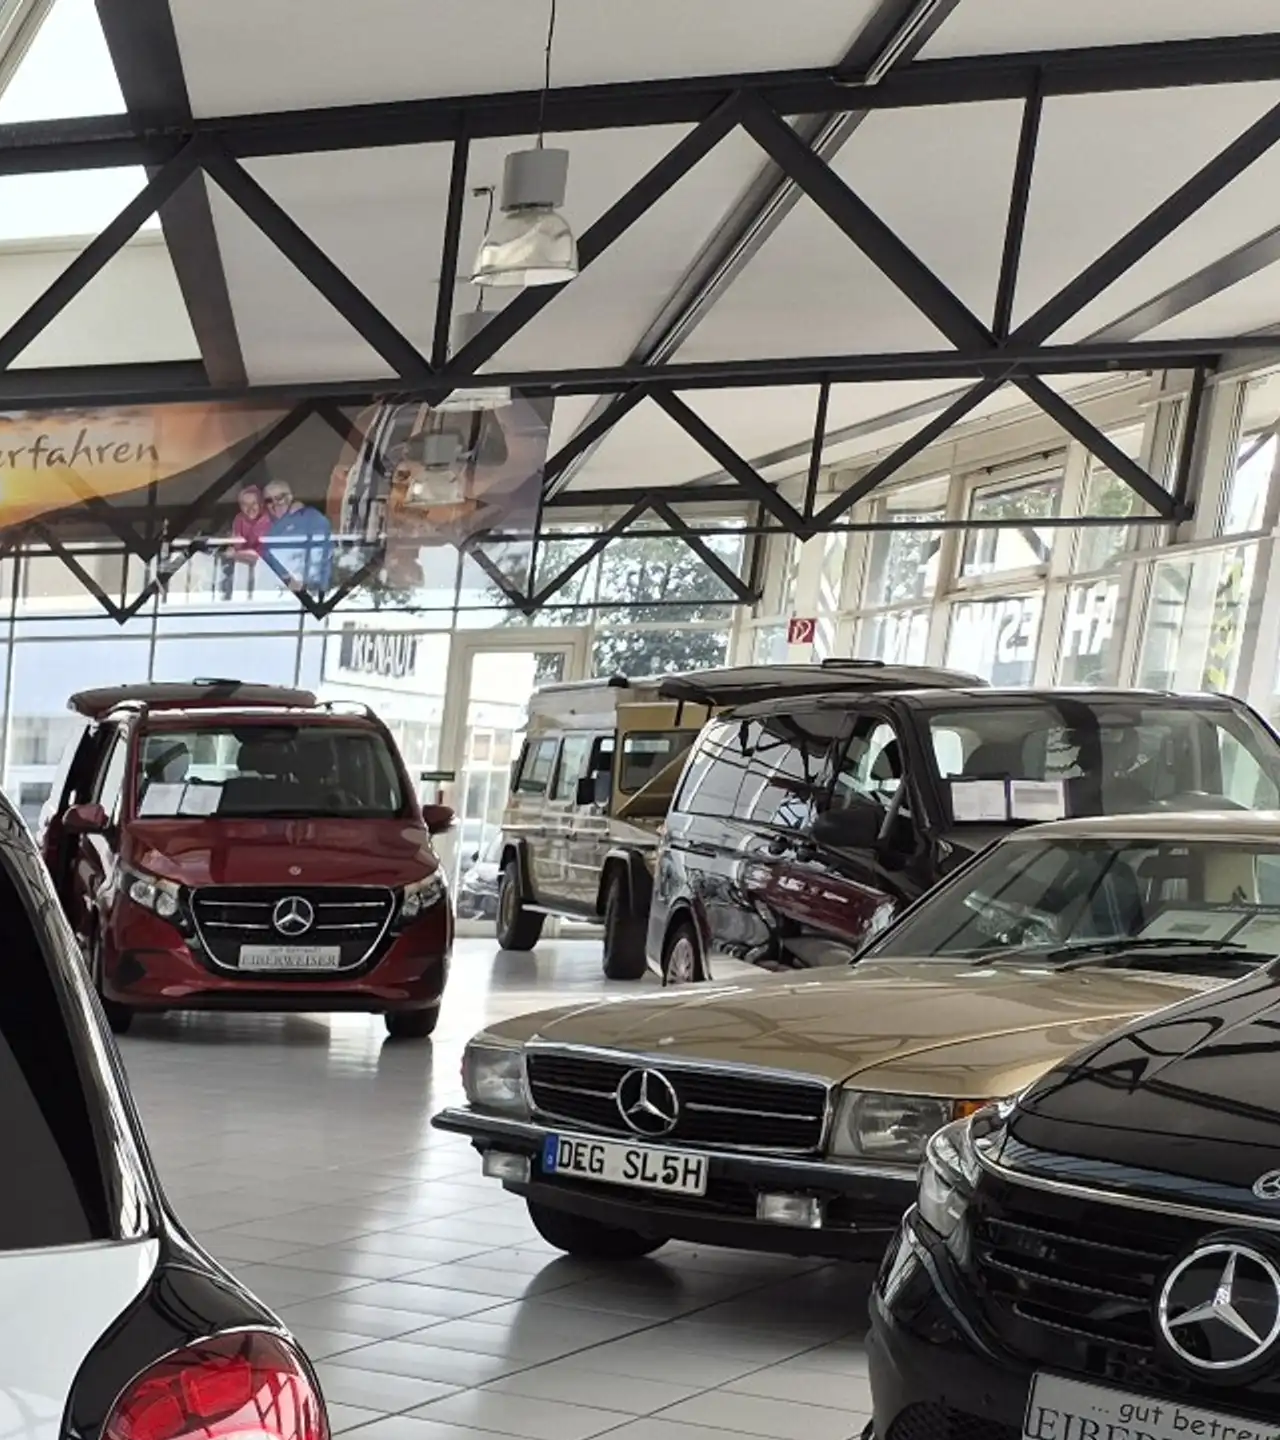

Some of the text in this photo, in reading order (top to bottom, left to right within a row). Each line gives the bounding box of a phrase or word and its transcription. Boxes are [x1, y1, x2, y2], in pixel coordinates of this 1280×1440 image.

[558, 1140, 703, 1190] DEG SL5H
[1118, 1403, 1164, 1425] gut
